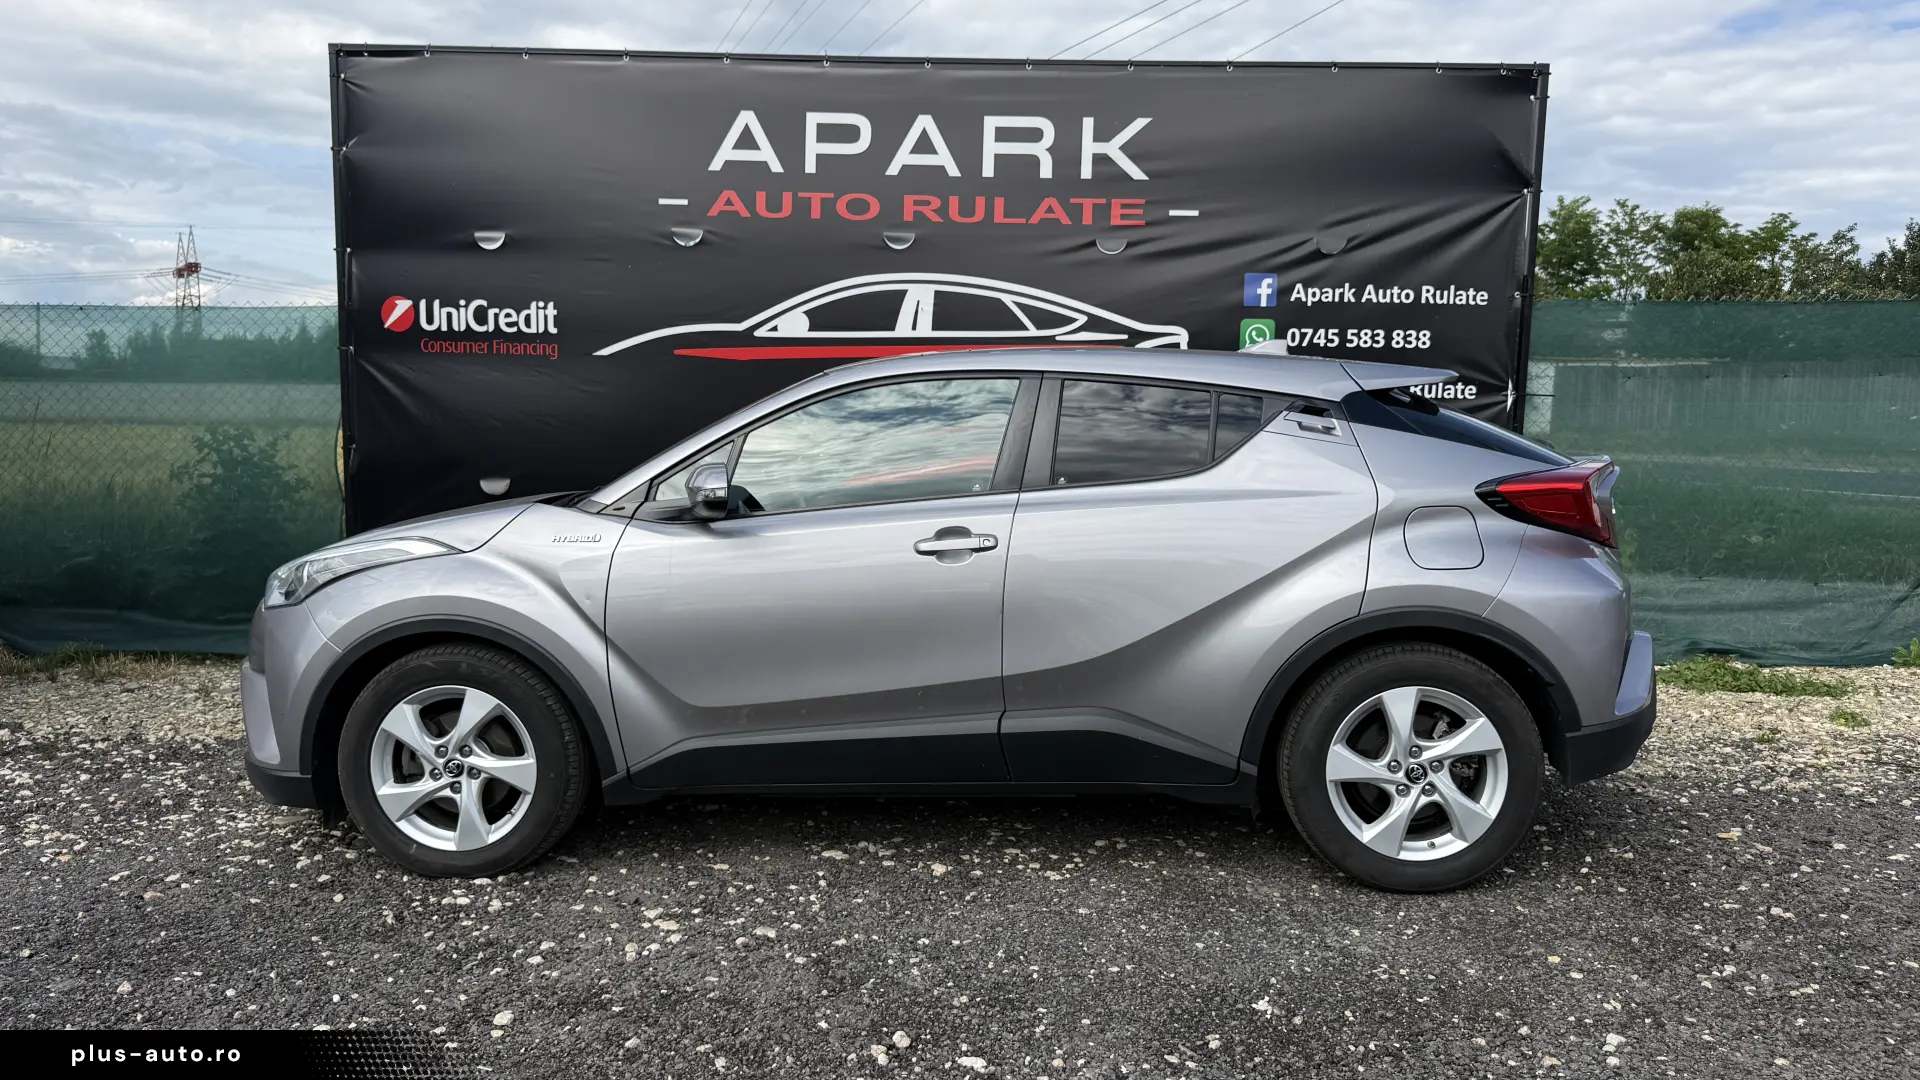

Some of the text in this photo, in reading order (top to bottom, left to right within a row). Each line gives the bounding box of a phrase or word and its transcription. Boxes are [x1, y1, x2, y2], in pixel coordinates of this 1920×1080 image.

[708, 110, 1154, 181] APARK
[706, 190, 1147, 226] AUTO RULATE
[1256, 277, 1273, 307] f
[1290, 283, 1489, 306] Apark Auto Rulate
[418, 298, 558, 335] UniCredit
[420, 338, 559, 360] Consumer Financing
[1286, 328, 1432, 349] 0745 583 838
